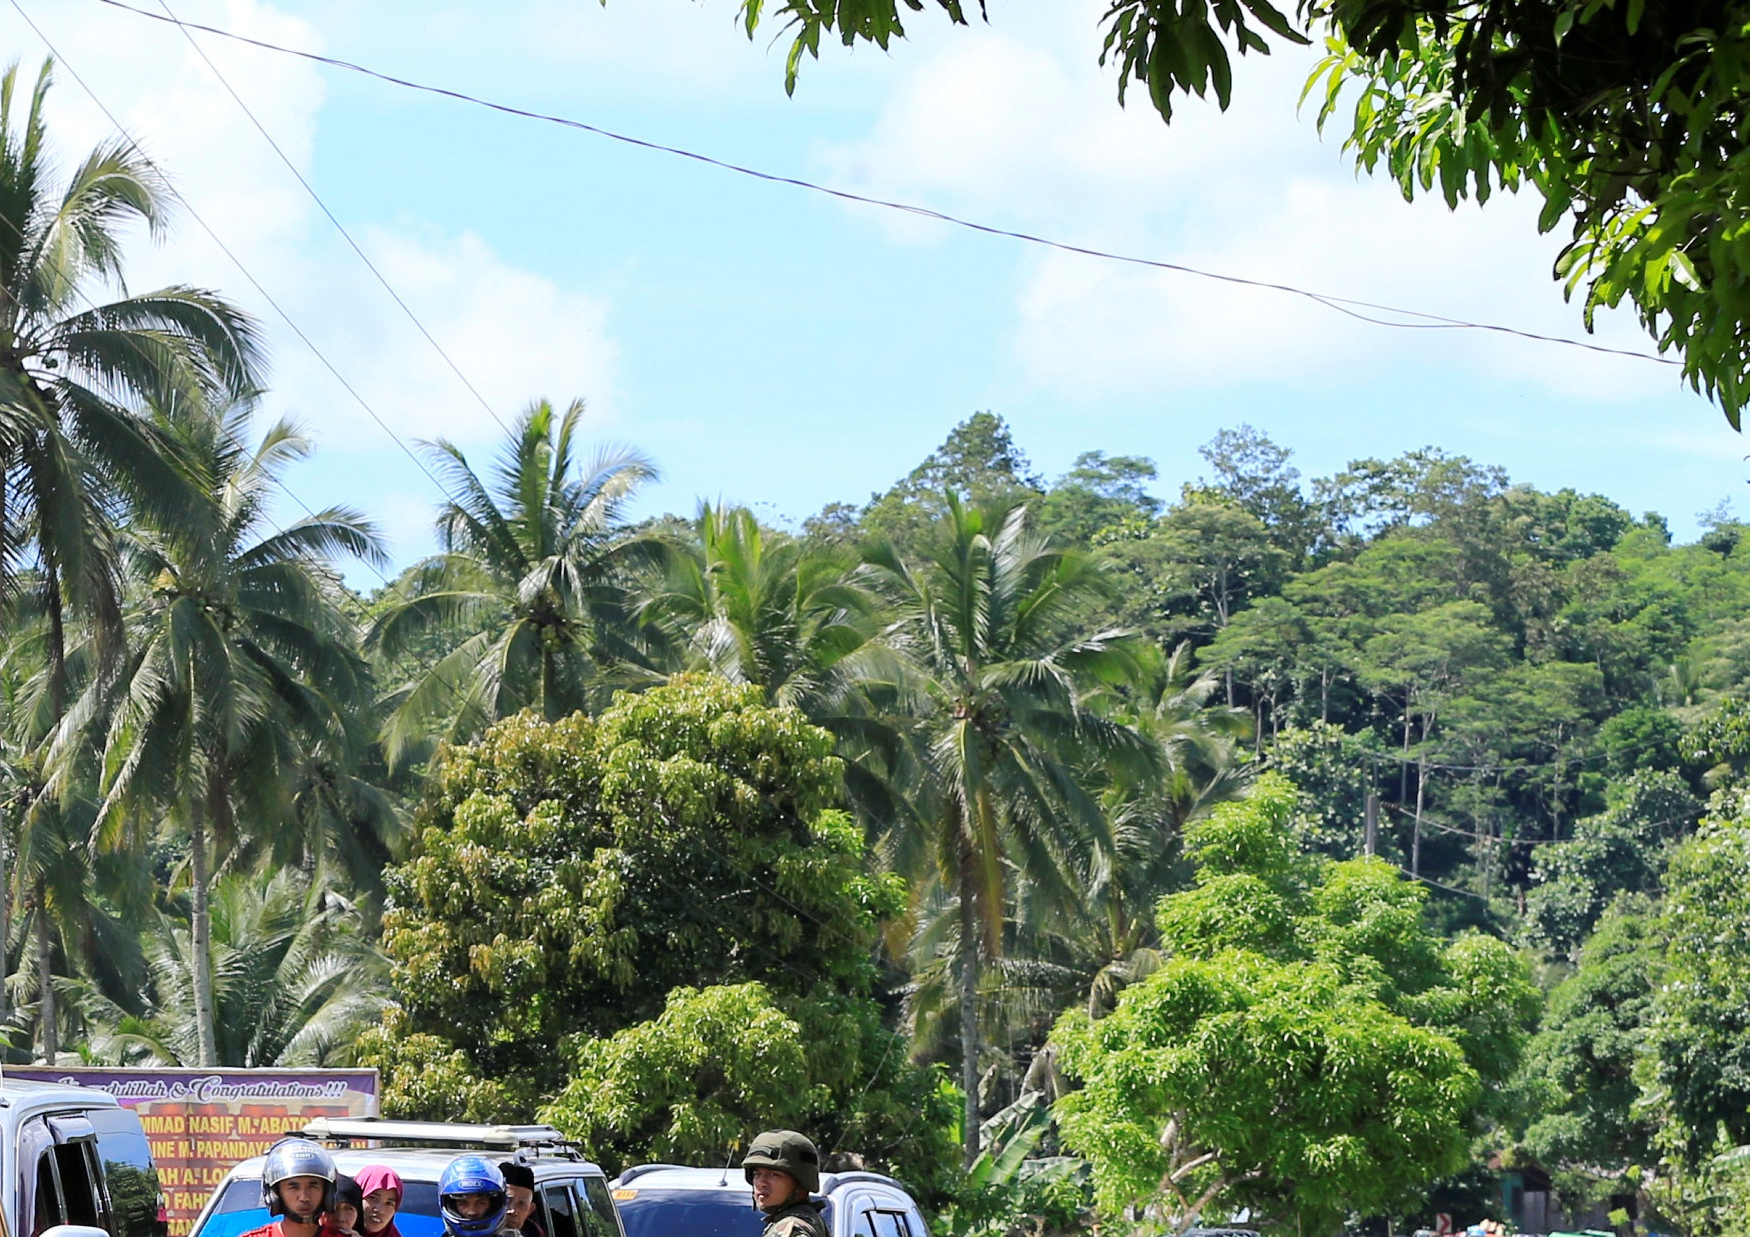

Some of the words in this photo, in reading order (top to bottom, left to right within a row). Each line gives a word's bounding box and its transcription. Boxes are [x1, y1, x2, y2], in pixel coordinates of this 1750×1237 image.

[171, 1083, 187, 1099] &
[191, 1076, 347, 1101] Congratulations!!!
[190, 1117, 234, 1134] NASIF
